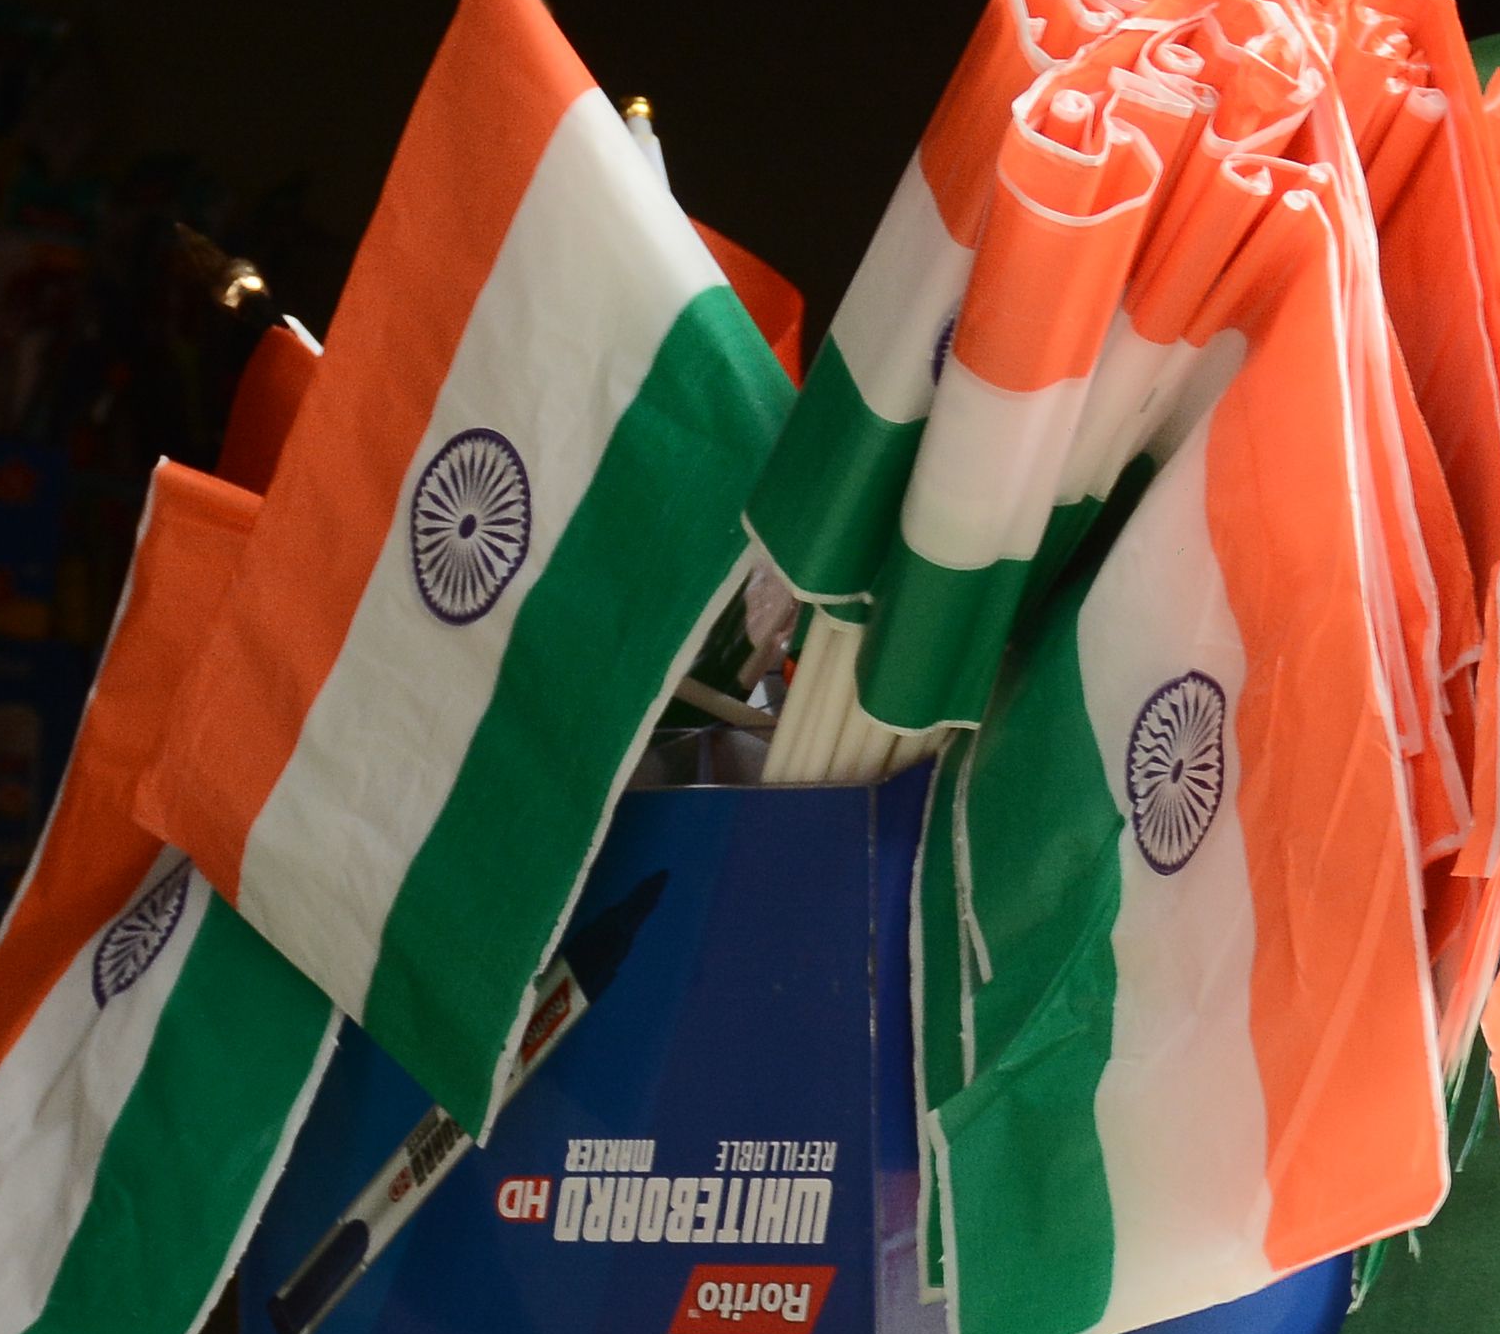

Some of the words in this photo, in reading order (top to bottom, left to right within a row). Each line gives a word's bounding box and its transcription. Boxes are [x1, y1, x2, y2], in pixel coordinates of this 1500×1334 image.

[564, 1138, 657, 1173] MARKER
[714, 1140, 839, 1173] REFILLABLE
[498, 1179, 551, 1219] HD
[552, 1176, 834, 1245] WHITEBOARD
[697, 1280, 812, 1323] Rorito
